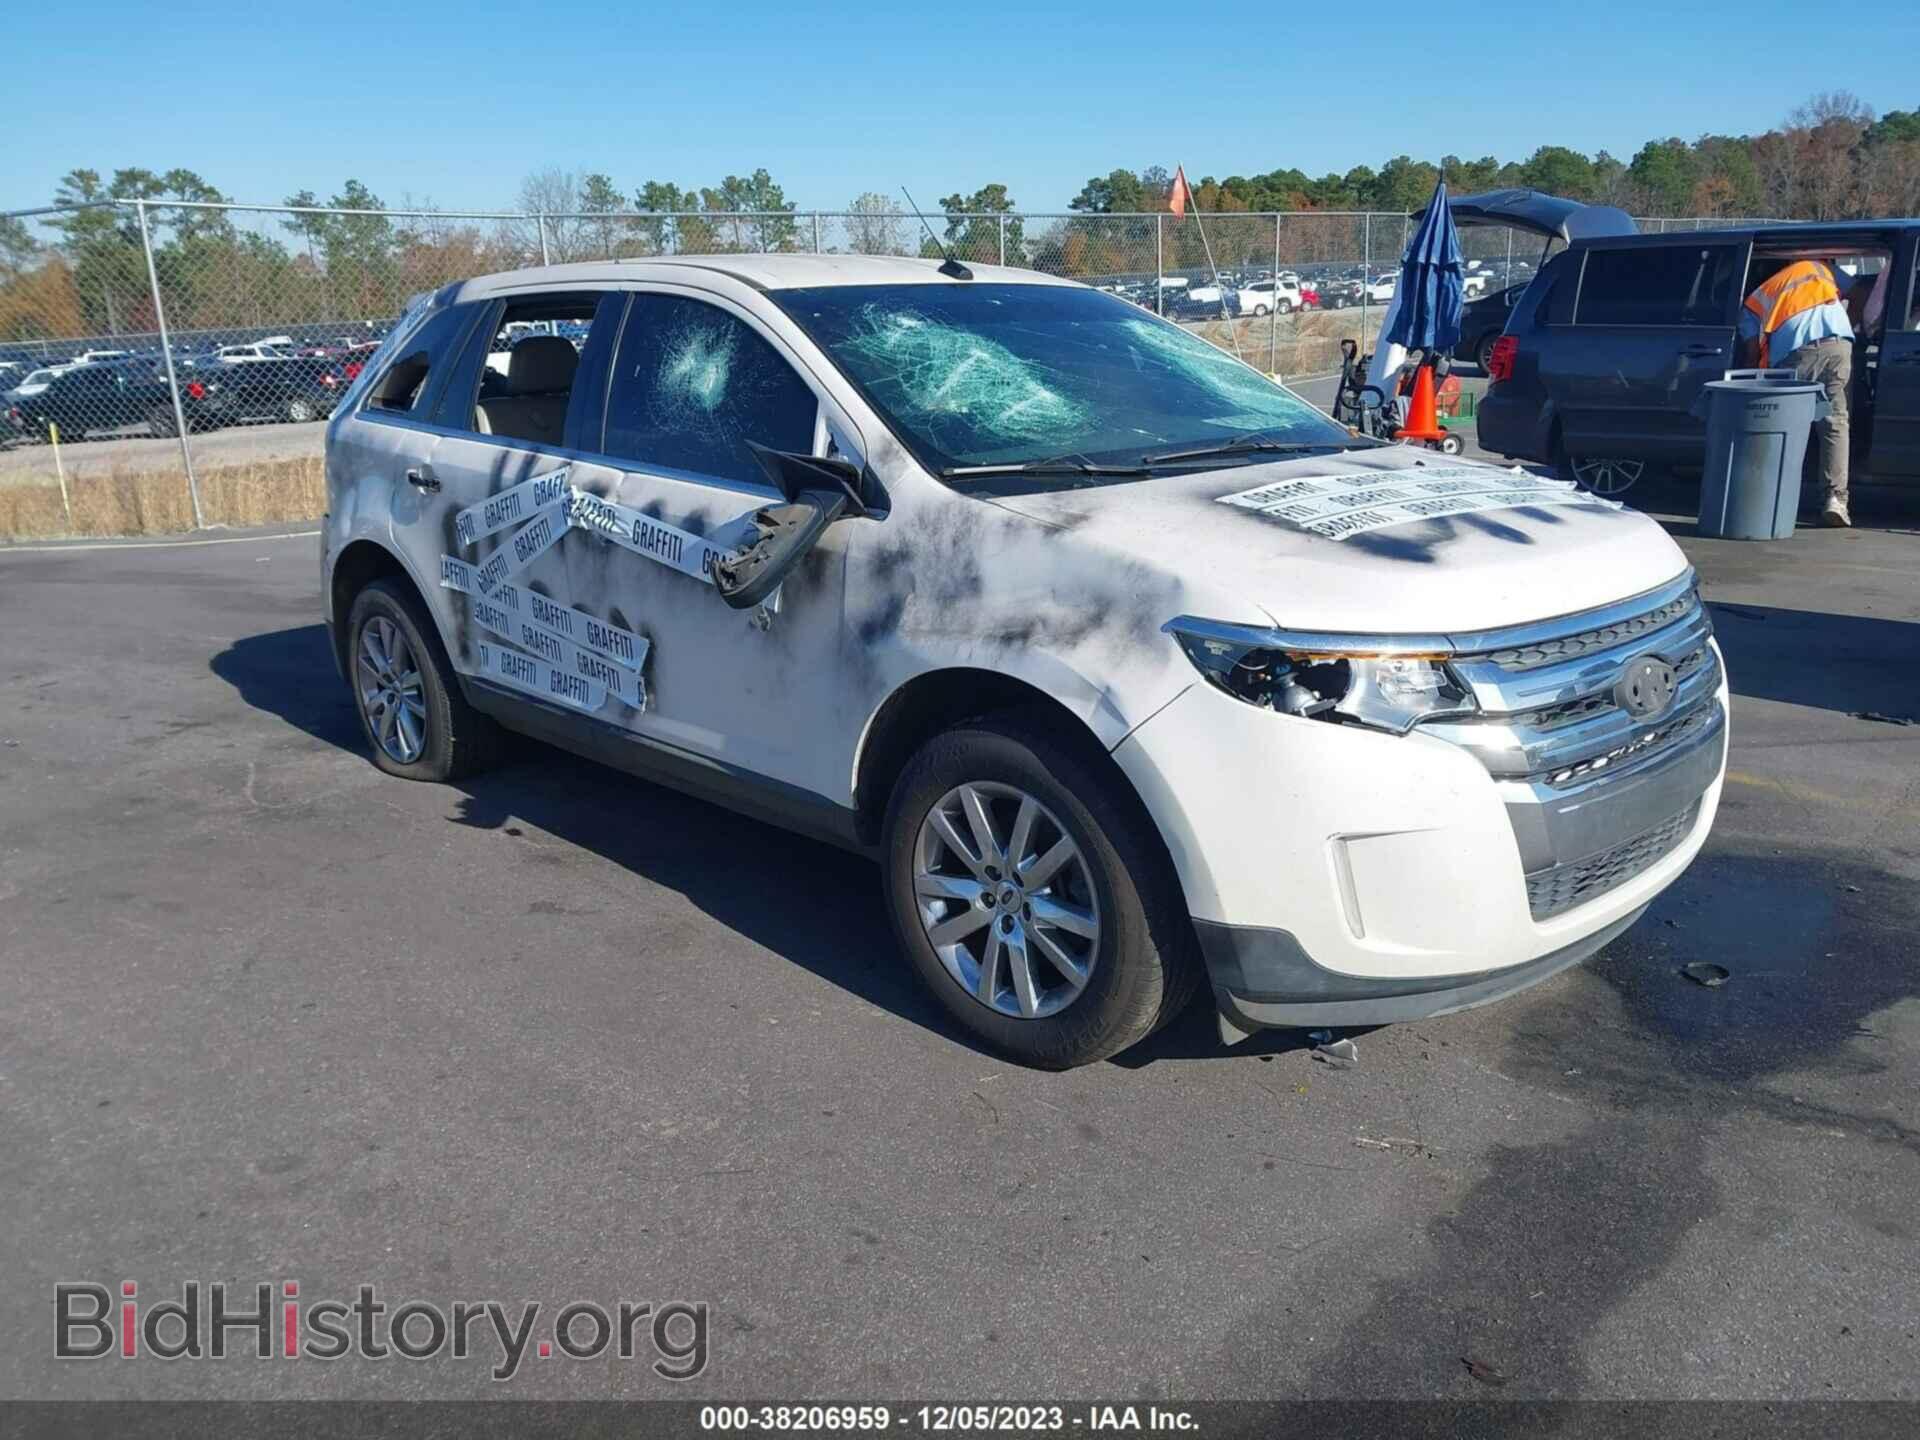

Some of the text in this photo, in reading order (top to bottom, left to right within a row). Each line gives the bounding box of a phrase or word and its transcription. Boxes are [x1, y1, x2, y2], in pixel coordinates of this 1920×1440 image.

[484, 492, 521, 528] GRAFFITI
[513, 517, 552, 563] GRAFFITI
[633, 519, 684, 564] GRAFFITI
[532, 596, 573, 635] GRAFFITI
[587, 620, 633, 661] GRAFFITI
[501, 651, 537, 686] GRAFFITI
[551, 669, 590, 705] GRAFFITI
[522, 623, 562, 663] GRAFFITI
[576, 652, 621, 693] GRAFFITI
